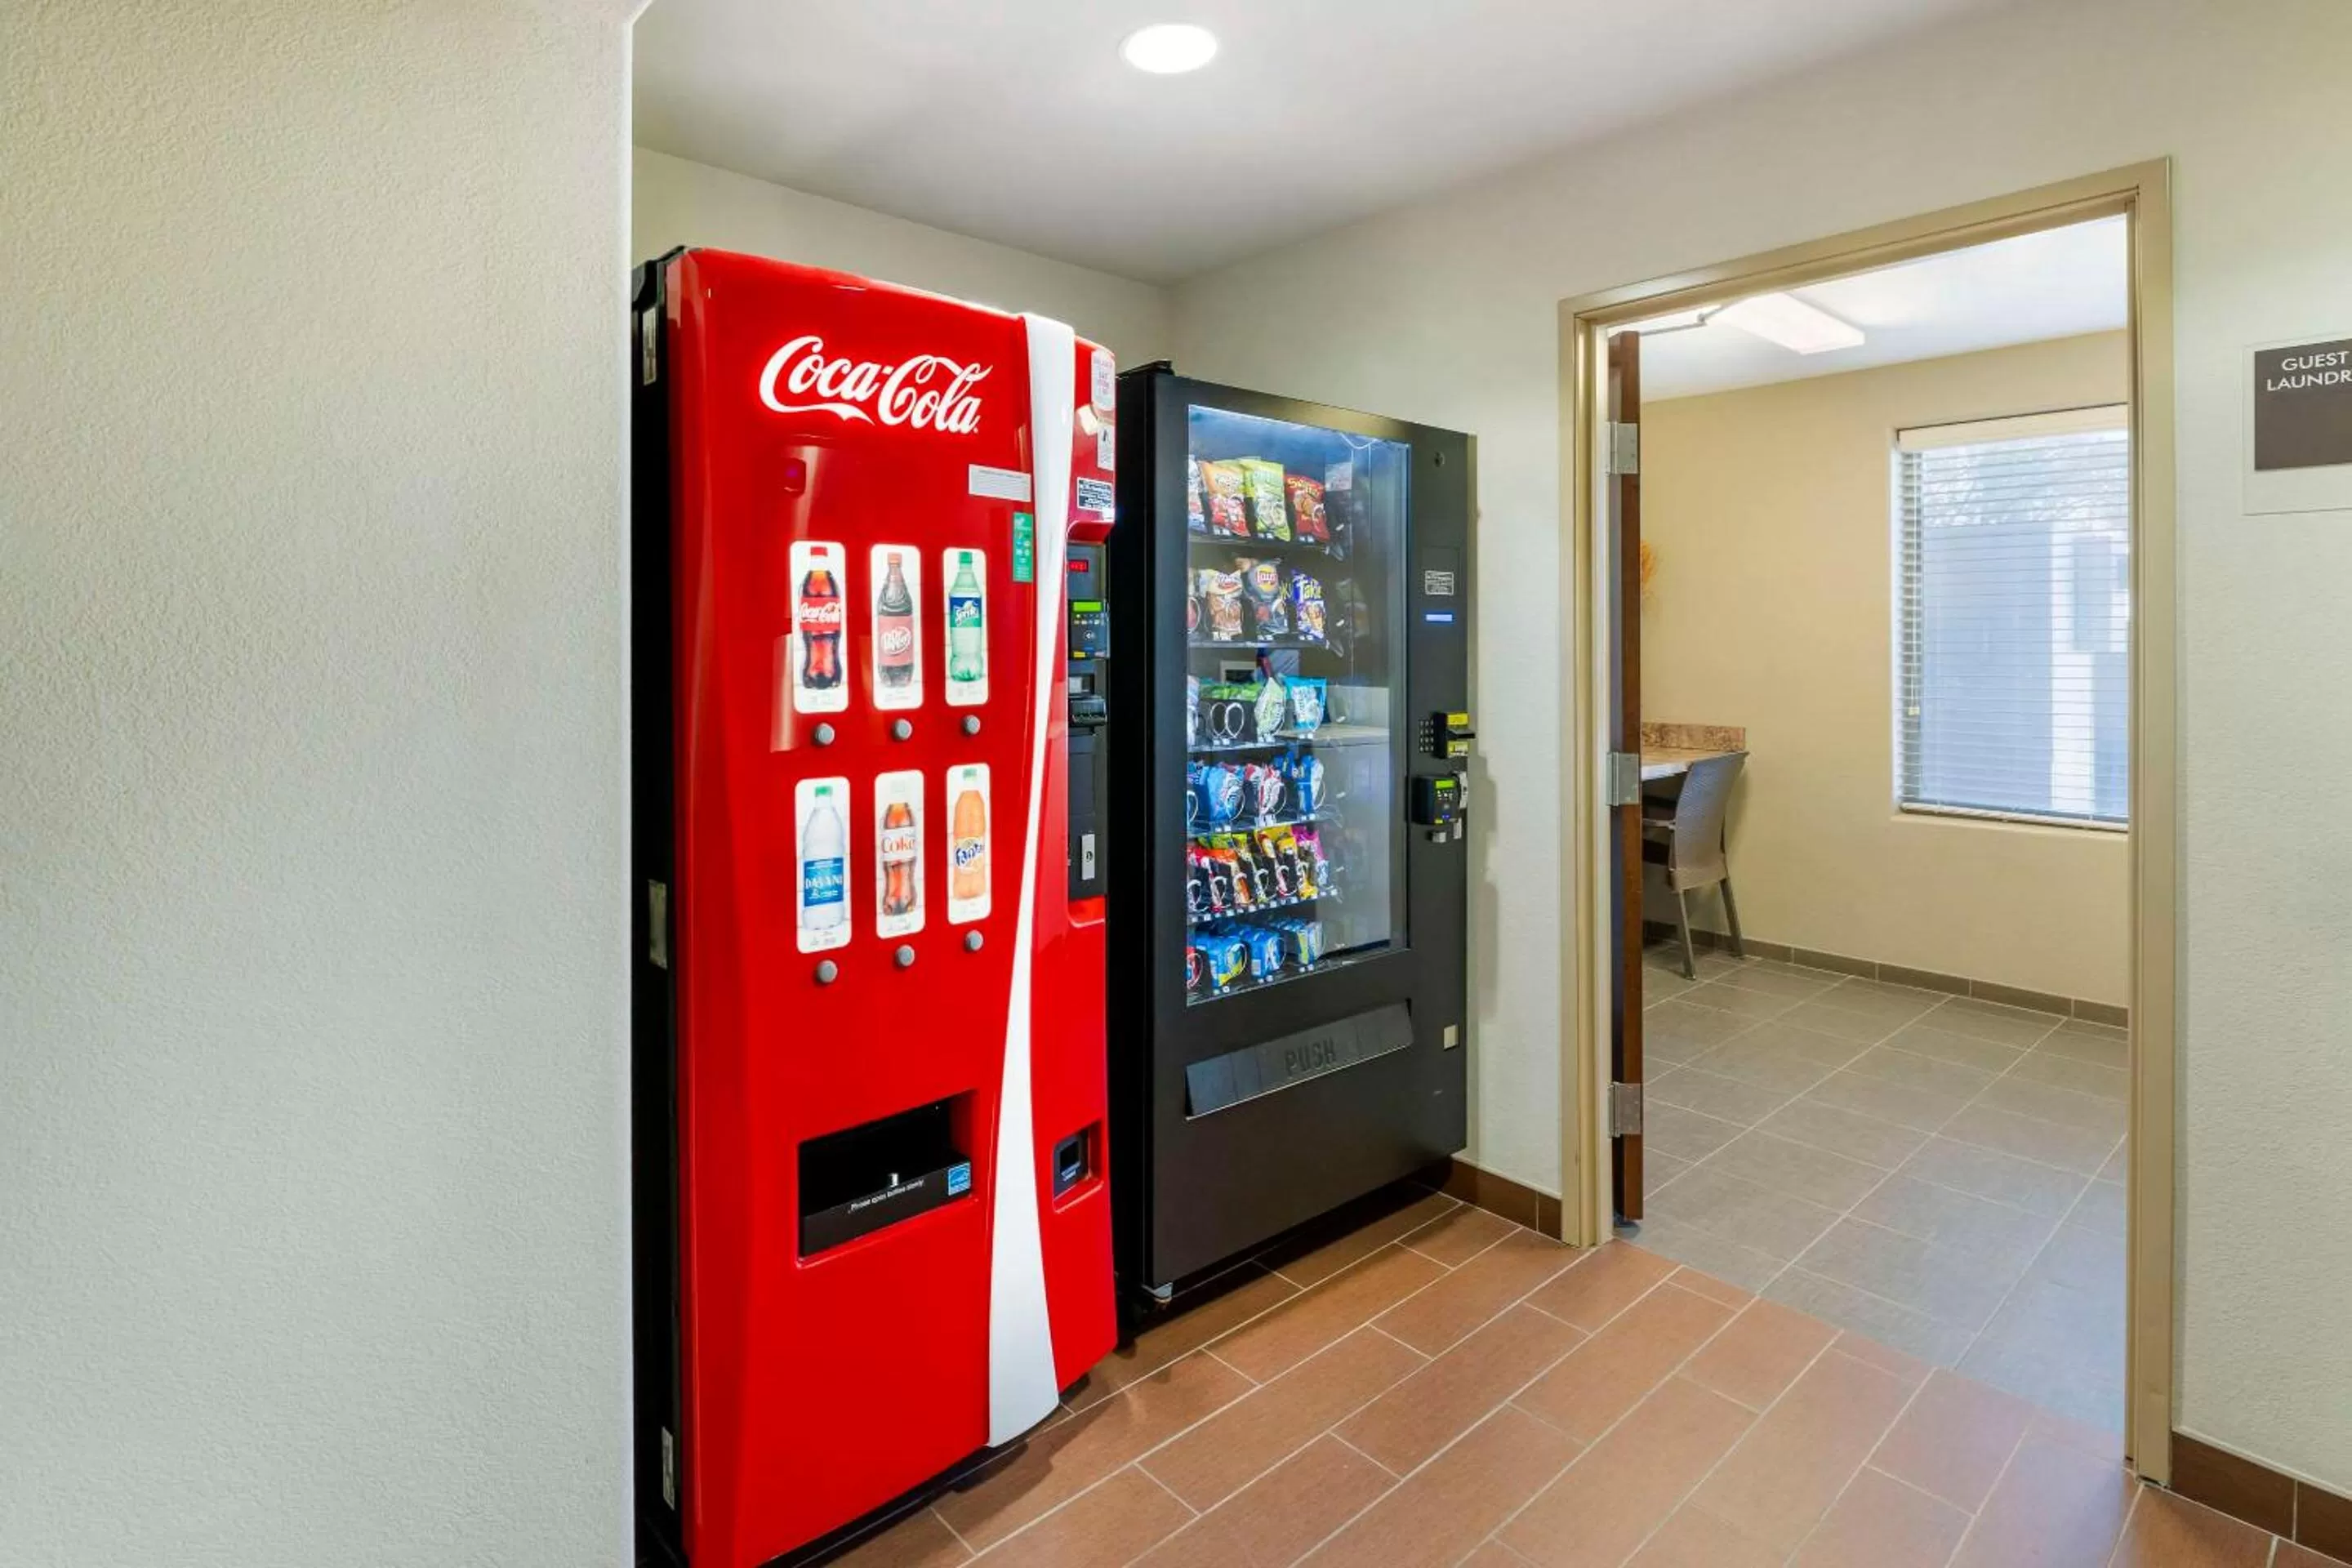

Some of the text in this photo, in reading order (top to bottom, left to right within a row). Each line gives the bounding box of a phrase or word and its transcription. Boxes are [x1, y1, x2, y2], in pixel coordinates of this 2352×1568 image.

[2281, 350, 2350, 371] GUEST
[758, 335, 993, 434] Coca-Cola
[1285, 1036, 1336, 1077] PUSH
